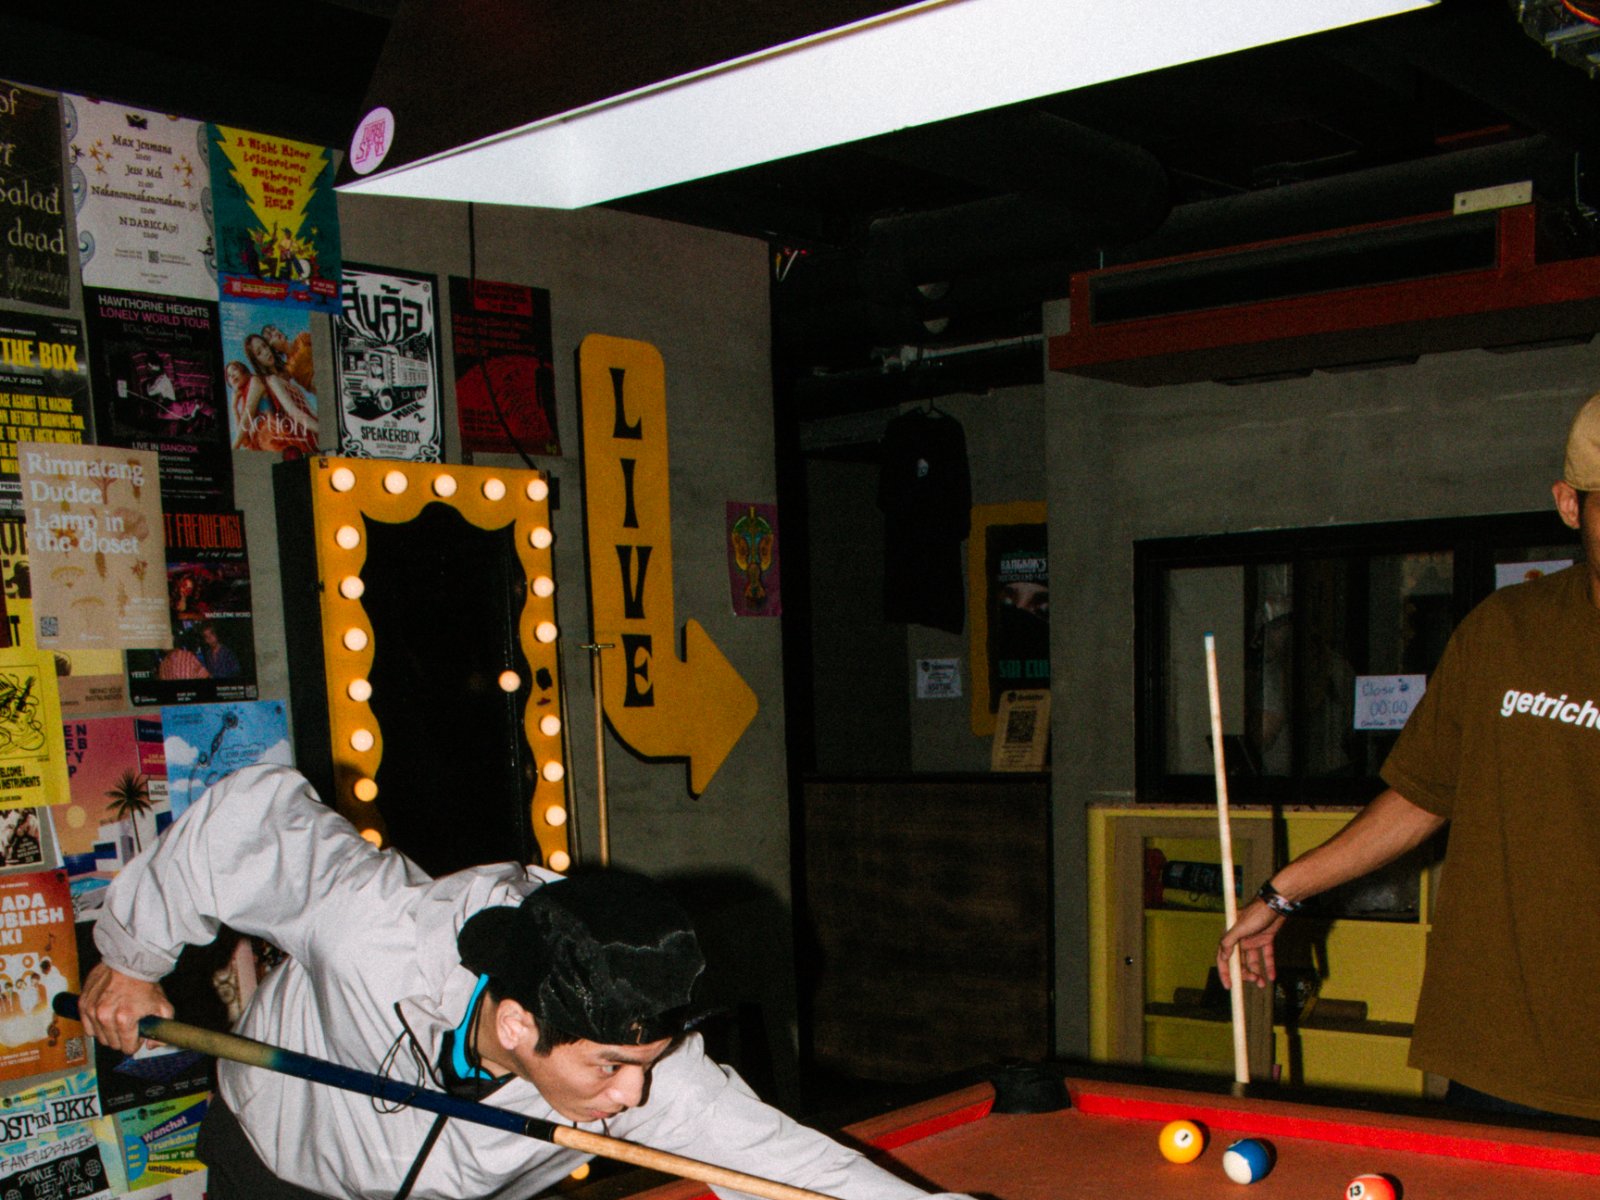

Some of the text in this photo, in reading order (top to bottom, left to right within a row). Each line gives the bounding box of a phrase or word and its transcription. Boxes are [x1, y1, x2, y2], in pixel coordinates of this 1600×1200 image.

[112, 134, 133, 148] Max
[7, 217, 66, 257] dead
[97, 294, 210, 318] HAWTHORNE HEIGHTS
[99, 307, 210, 331] LONELY WORLD TOUR
[0, 337, 79, 372] THE BOX
[391, 402, 425, 421] MARK
[413, 412, 426, 423] 2
[132, 441, 149, 450] LIVE
[150, 443, 159, 451] IN
[360, 426, 421, 444] SPEAKERBOX
[26, 452, 145, 486] Rimnatang
[30, 480, 103, 504] Dudee
[32, 508, 125, 532] Lamp in
[35, 529, 72, 553] the
[79, 529, 140, 555] closet
[609, 367, 655, 707] LIVE
[33, 1112, 51, 1129] IN
[50, 1094, 99, 1125] BKK
[142, 1114, 188, 1143] Wanchat
[1349, 1185, 1361, 1198] 13
